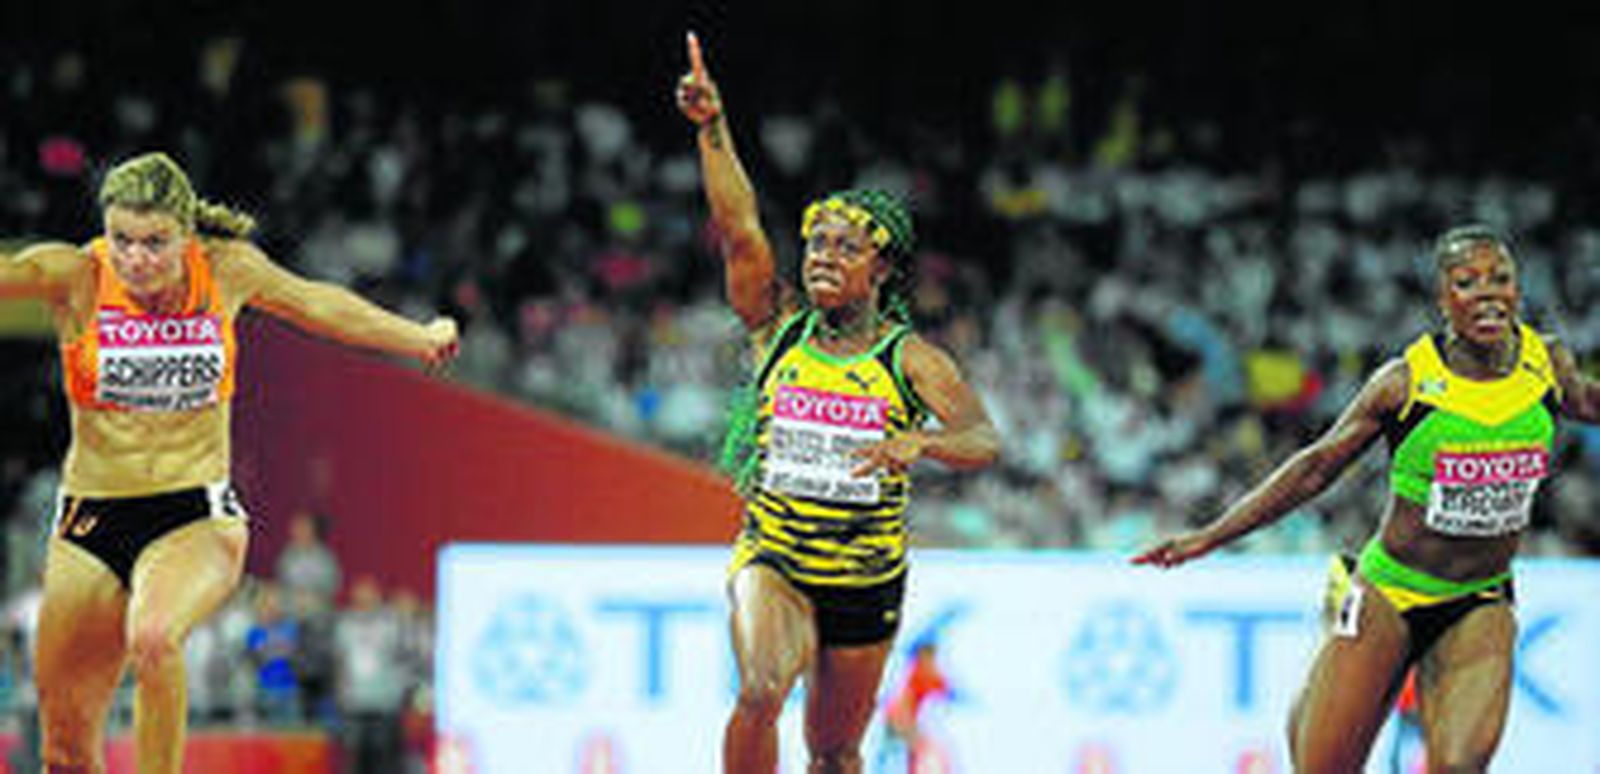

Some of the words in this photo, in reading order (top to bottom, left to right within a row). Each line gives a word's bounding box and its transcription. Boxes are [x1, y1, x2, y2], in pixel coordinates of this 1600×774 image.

[102, 318, 218, 342] TOYOTA
[777, 391, 881, 422] TOYOTA
[1441, 453, 1543, 480] TOYOTA
